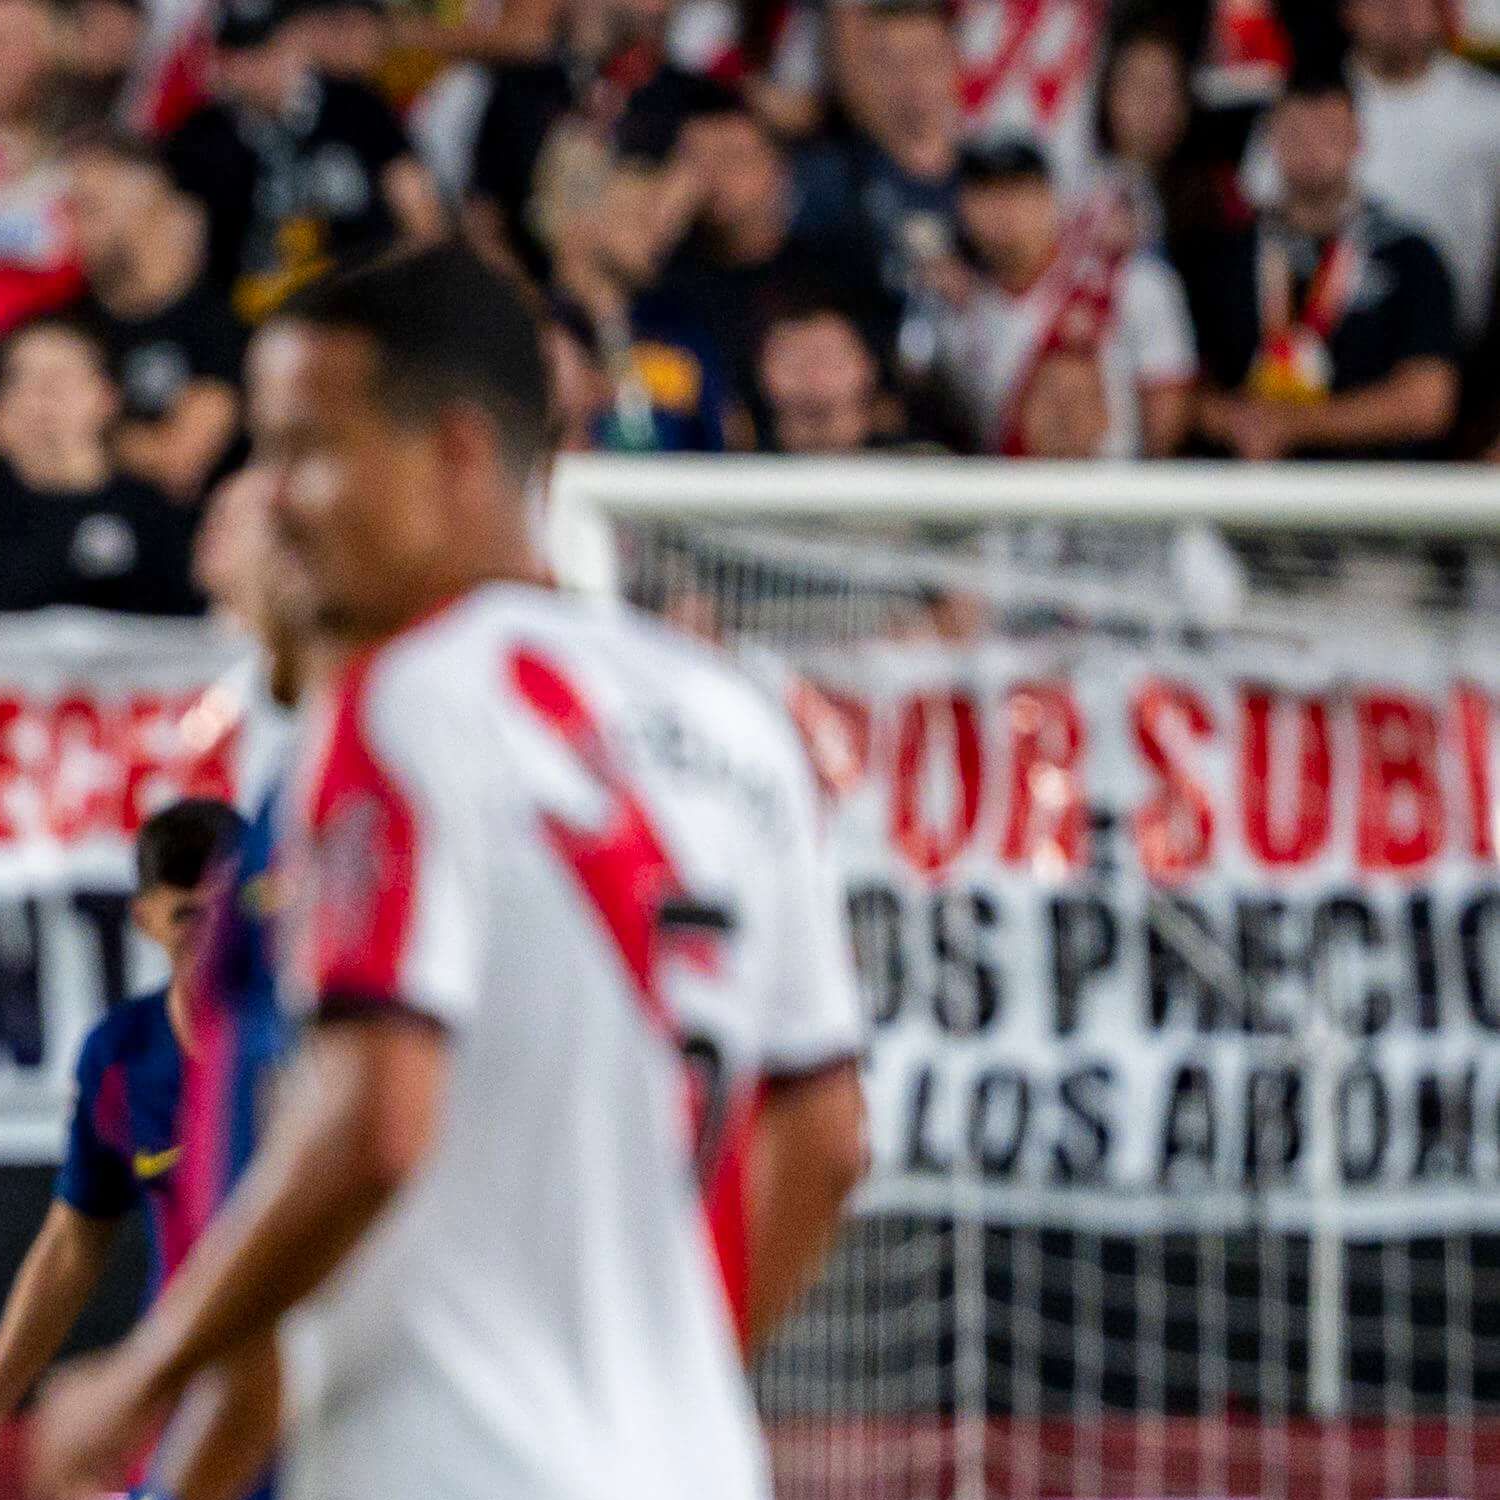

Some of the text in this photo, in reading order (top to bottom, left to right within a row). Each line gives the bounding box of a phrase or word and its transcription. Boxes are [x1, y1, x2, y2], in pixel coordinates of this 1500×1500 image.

[1128, 675, 1500, 882] SUBI
[1045, 885, 1500, 1040] PRECIO
[905, 1058, 1110, 1186] LOS
